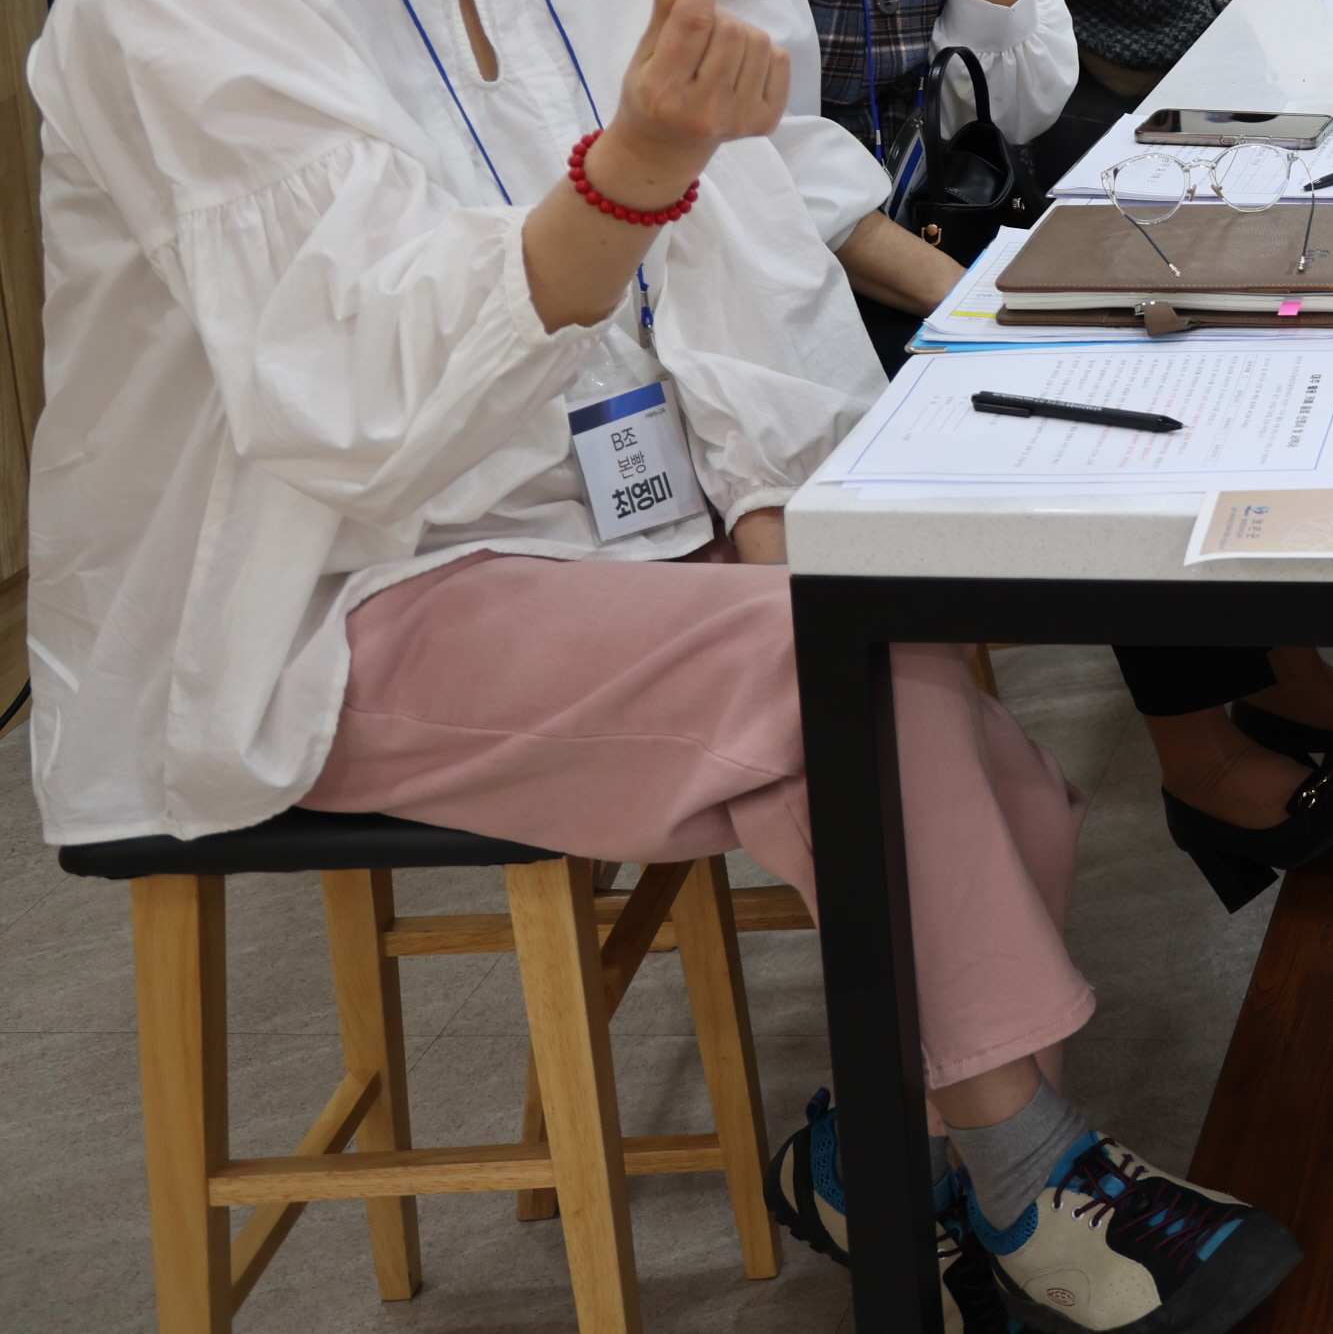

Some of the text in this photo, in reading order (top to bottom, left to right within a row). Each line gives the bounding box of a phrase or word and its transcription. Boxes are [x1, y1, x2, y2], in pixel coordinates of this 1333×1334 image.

[1309, 374, 1322, 384] 대추
[1305, 385, 1318, 394] 활용
[1301, 395, 1315, 404] 카페
[1299, 405, 1311, 414] 음료
[611, 427, 638, 452] B조
[618, 450, 647, 479] 본빵
[612, 471, 673, 519] 최영미
